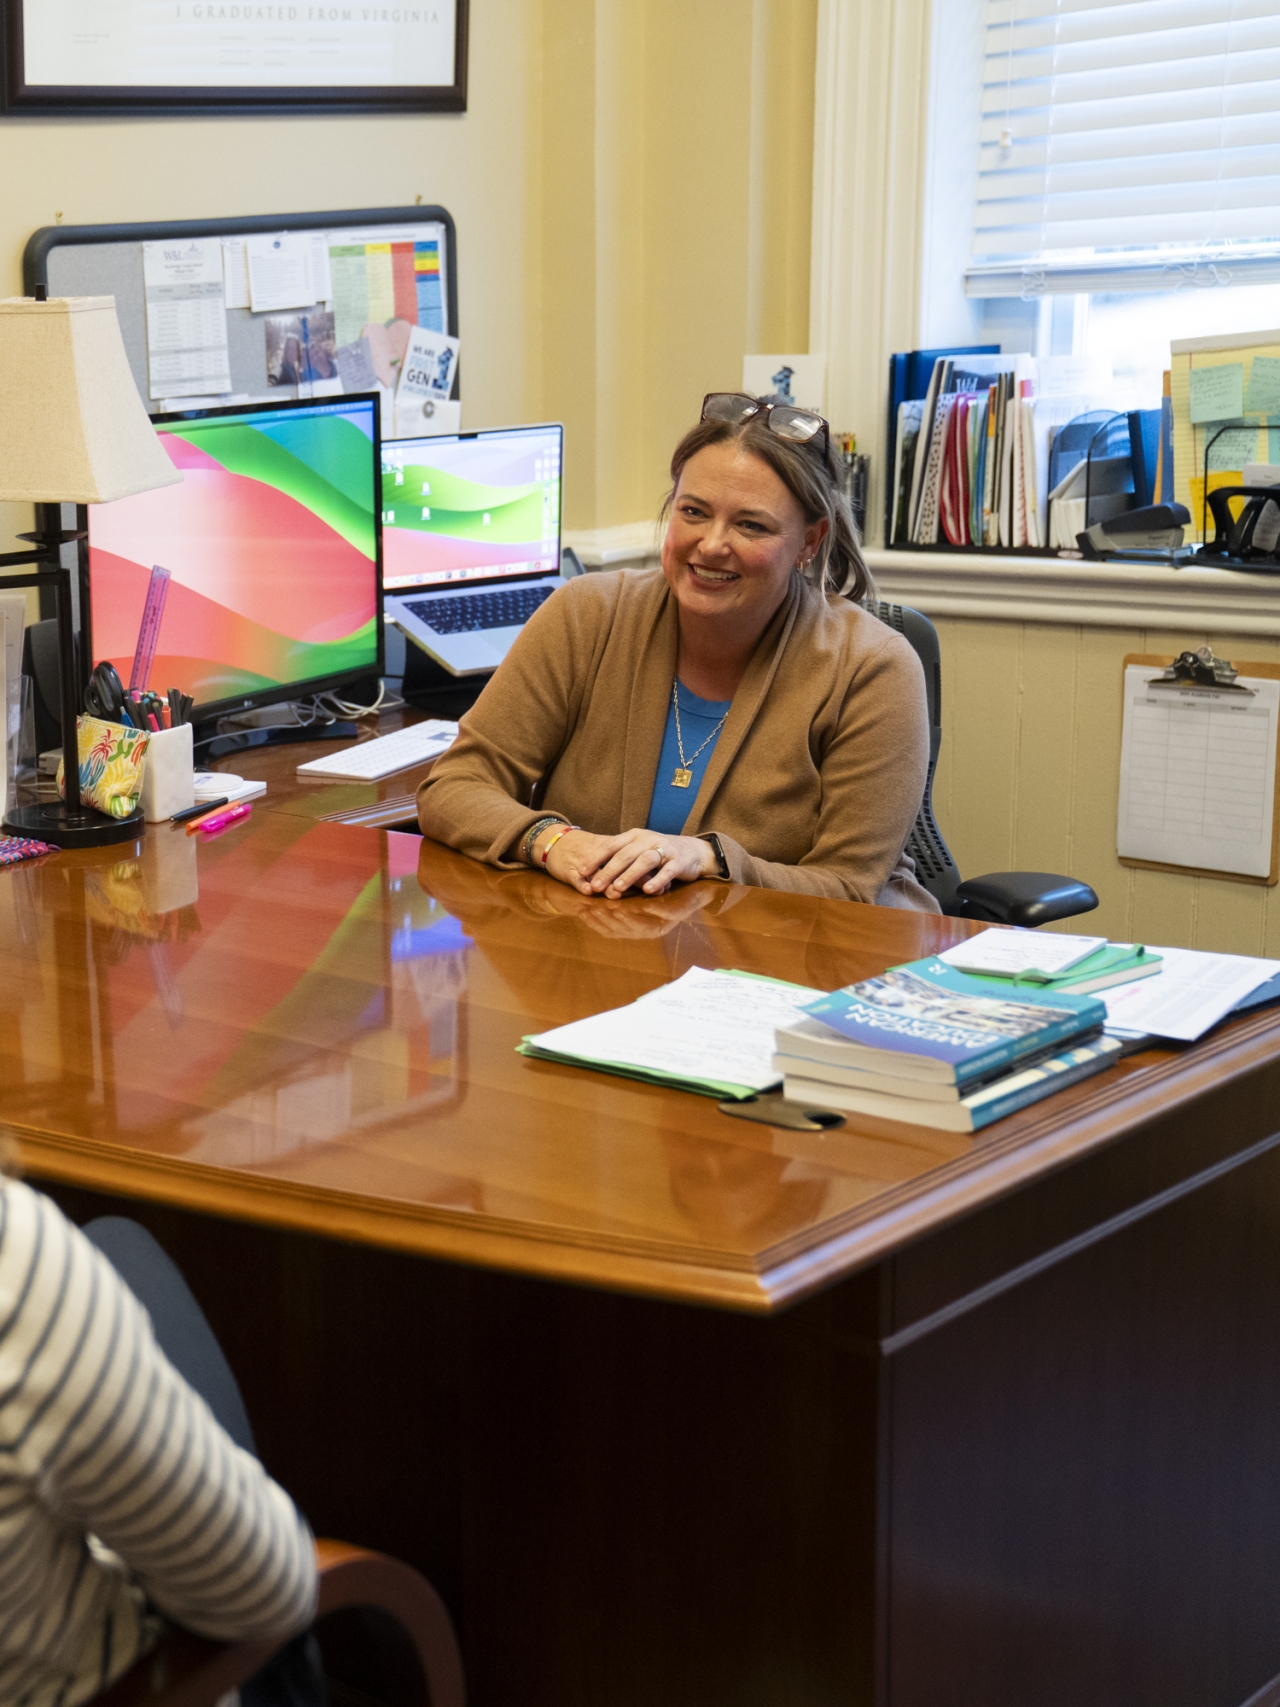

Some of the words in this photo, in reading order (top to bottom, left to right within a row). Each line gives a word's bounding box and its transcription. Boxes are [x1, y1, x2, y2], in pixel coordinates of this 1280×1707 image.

[193, 5, 297, 20] GRADUATED
[308, 8, 352, 21] FROM
[362, 9, 438, 23] VIRGINIA
[407, 368, 430, 386] GEN
[844, 1011, 986, 1049] AMERICAN
[847, 1003, 1000, 1043] EDUCATION
